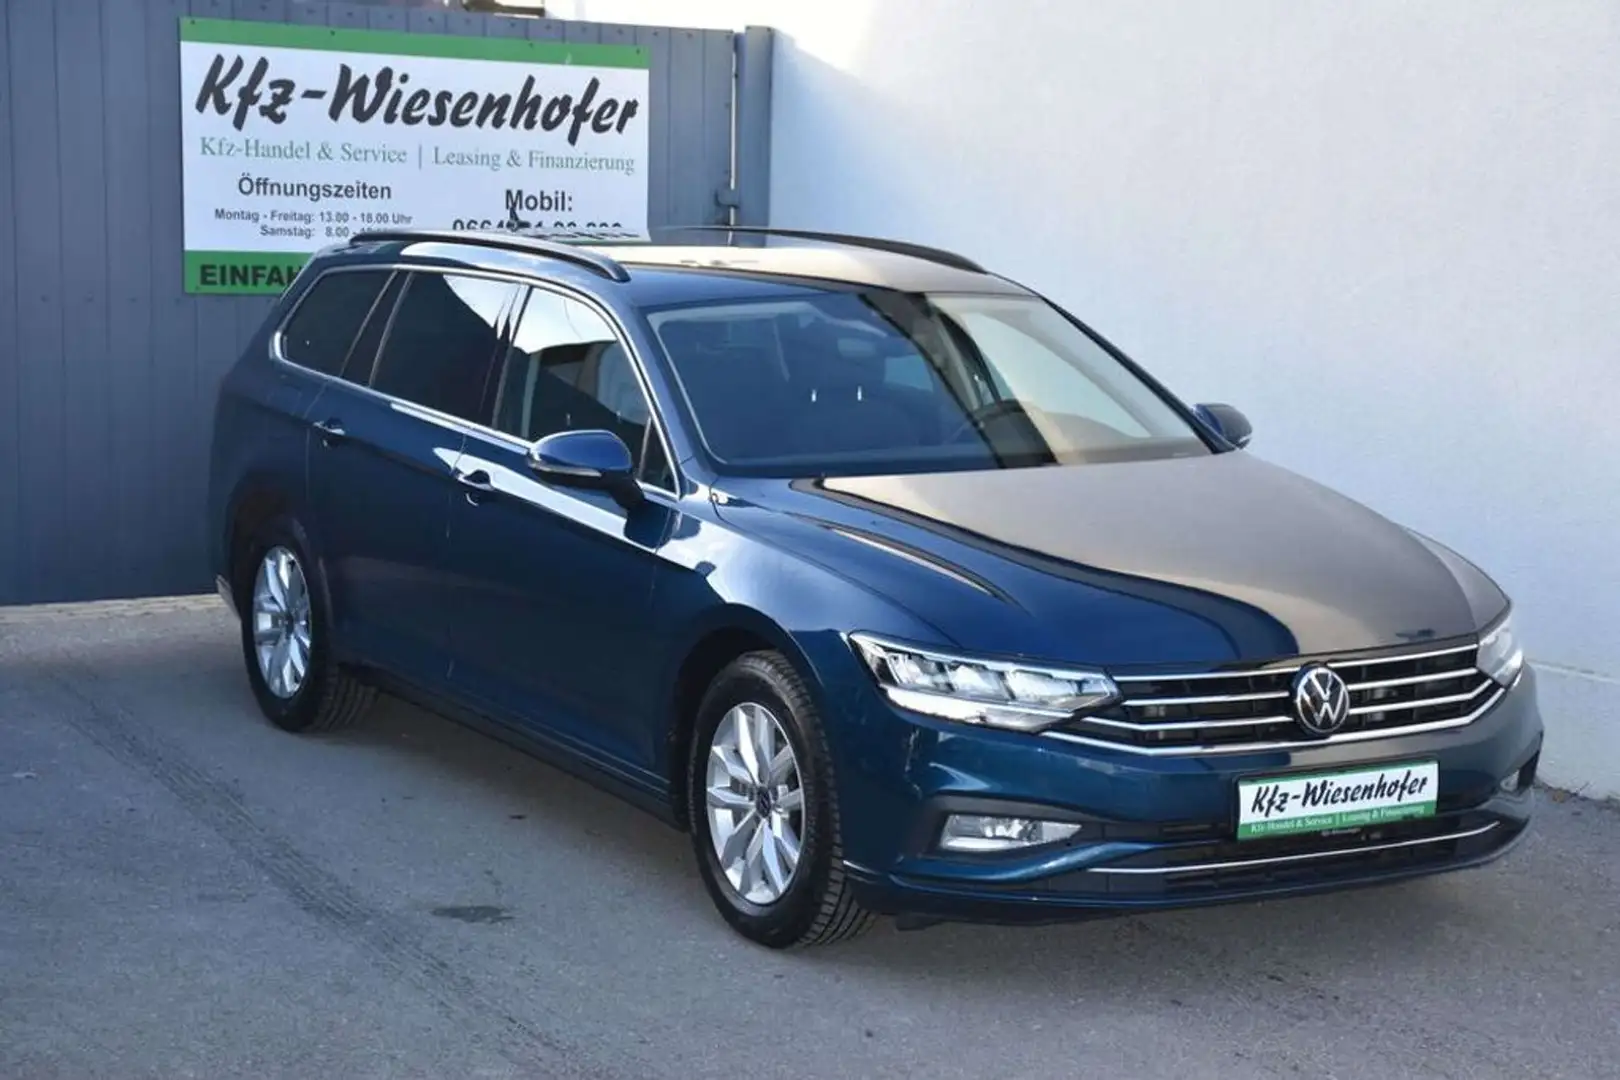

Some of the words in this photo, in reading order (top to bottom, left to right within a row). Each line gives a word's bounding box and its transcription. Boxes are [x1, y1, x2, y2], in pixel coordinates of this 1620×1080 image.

[195, 54, 638, 146] Kfz-Wiesenhofer
[200, 136, 310, 160] Kfz-Handel
[317, 141, 334, 161] &
[340, 142, 408, 164] Service
[433, 146, 501, 171] Leasing
[506, 149, 522, 168] &
[528, 150, 636, 175] Finanzierung
[238, 172, 392, 201] Öffnungszeiten
[505, 189, 573, 212] Mobil:
[214, 208, 260, 223] Montag
[270, 210, 315, 225] Freitag:
[392, 213, 413, 224] Uhr
[260, 226, 315, 239] Samstag:
[1251, 769, 1428, 818] Kfz-Wiesenhofer
